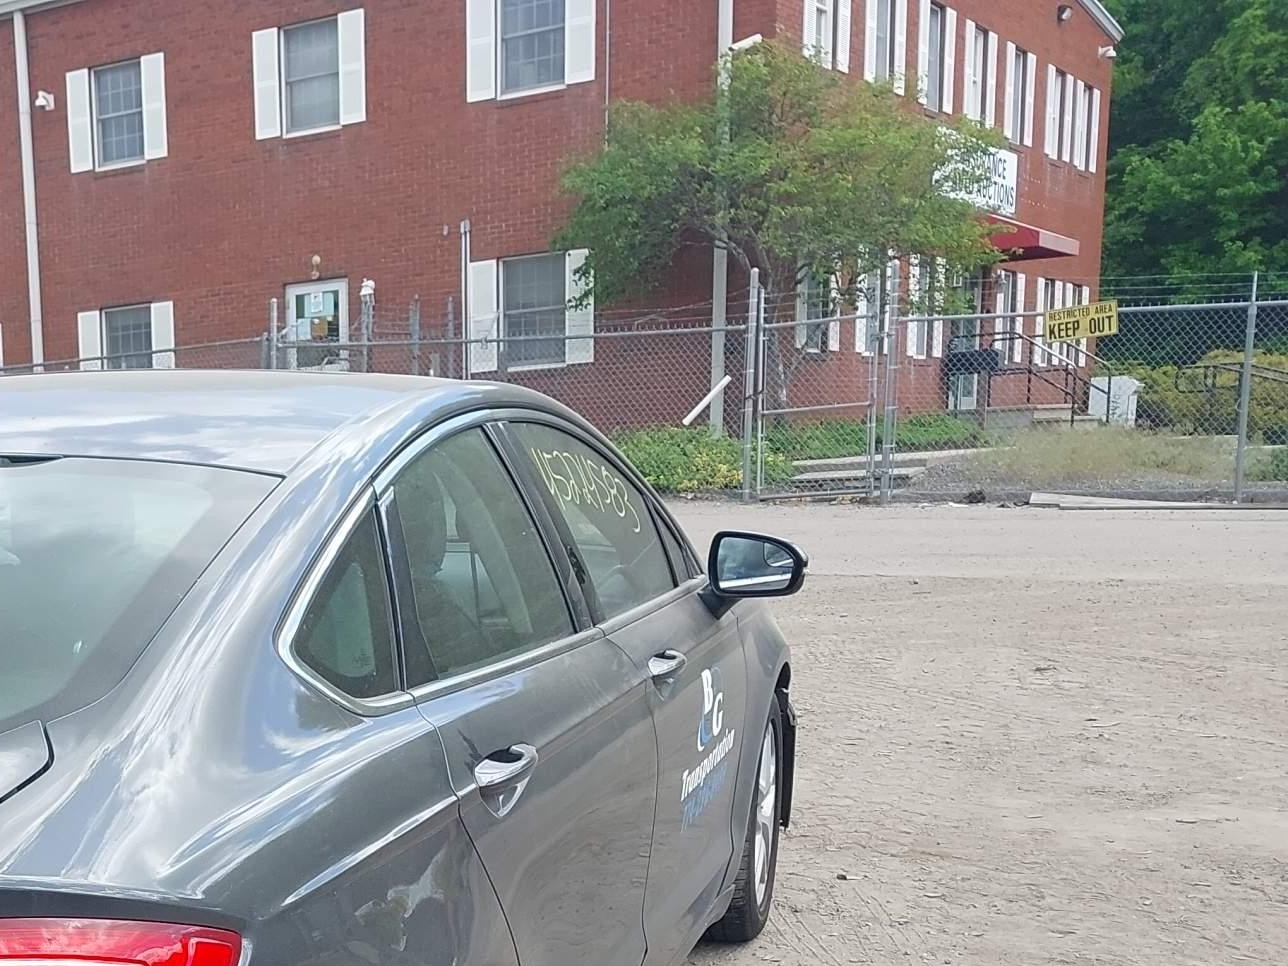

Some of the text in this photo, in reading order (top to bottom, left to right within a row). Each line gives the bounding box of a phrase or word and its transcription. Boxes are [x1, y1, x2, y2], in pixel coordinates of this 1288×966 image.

[1048, 303, 1113, 322] RESTRICTED AREA
[1048, 315, 1114, 340] KEEP OUT
